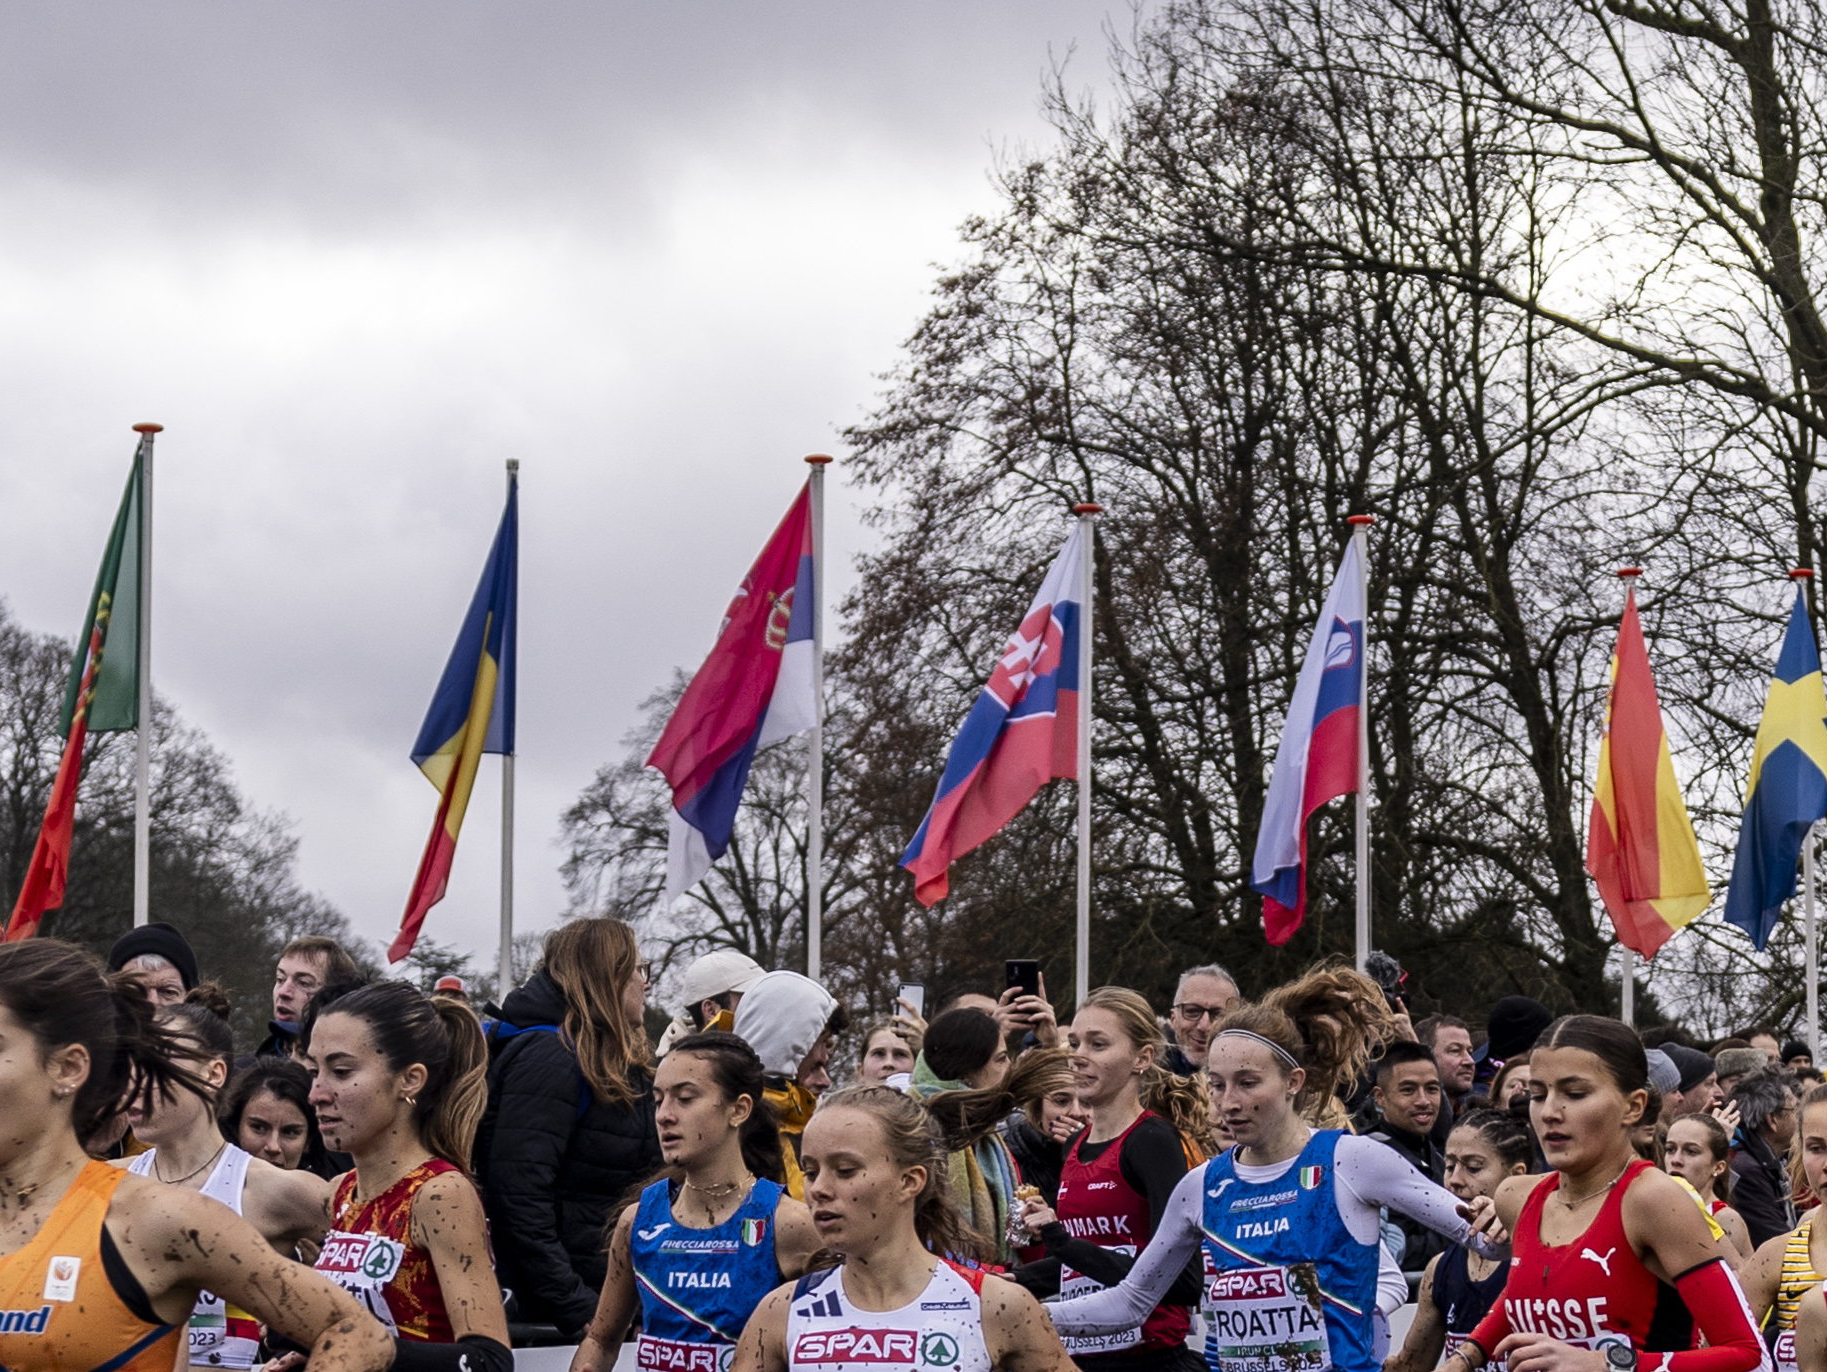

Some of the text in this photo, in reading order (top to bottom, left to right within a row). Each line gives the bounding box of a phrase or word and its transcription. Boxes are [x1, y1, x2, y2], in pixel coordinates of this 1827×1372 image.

[1230, 1189, 1299, 1209] FRECCIAROSSA
[1236, 1217, 1290, 1239] ITALIA
[667, 1272, 731, 1288] ITALIA
[1212, 1273, 1283, 1298] SPAR
[1216, 1304, 1320, 1339] ROATTA
[188, 1332, 217, 1346] 023
[797, 1333, 914, 1360] SPAR
[1109, 1330, 1136, 1345] 2023
[639, 1343, 714, 1372] SPAR
